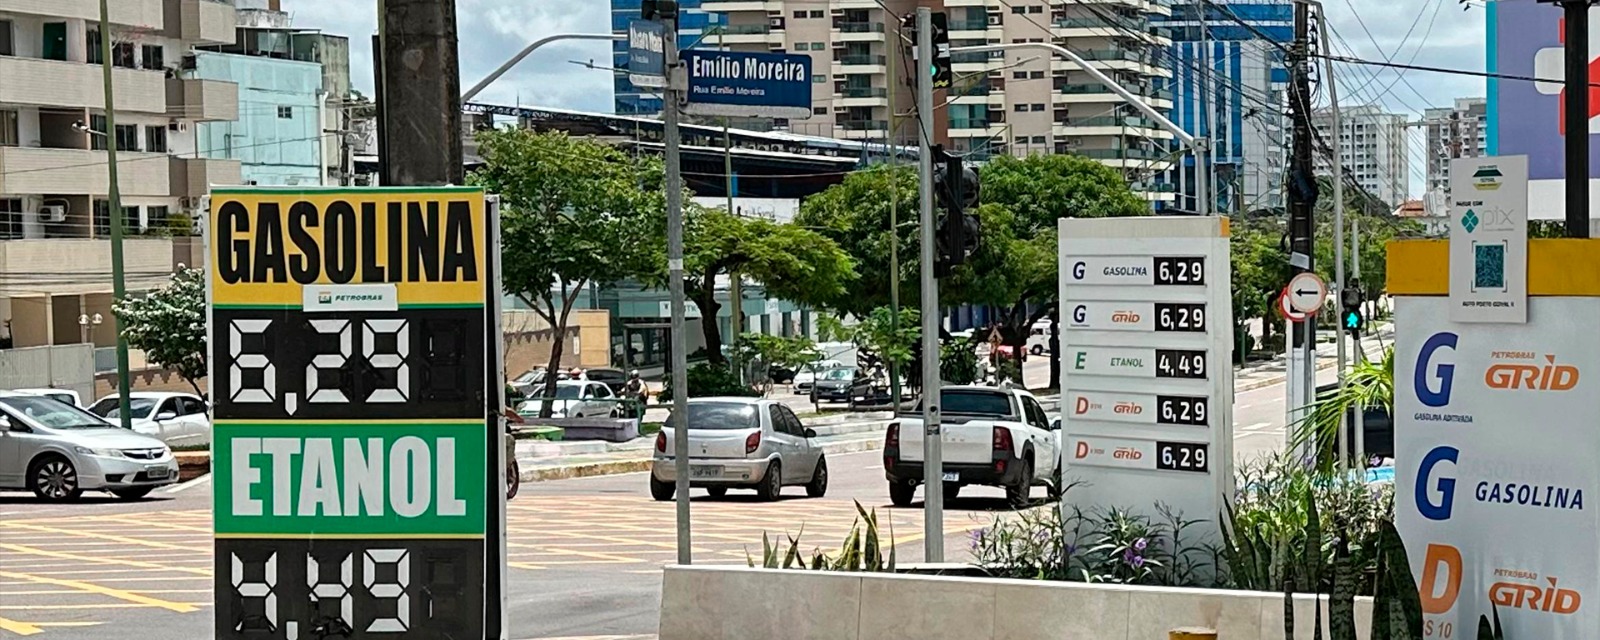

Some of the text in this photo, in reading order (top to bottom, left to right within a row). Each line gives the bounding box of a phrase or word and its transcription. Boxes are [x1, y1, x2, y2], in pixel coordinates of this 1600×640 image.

[692, 54, 804, 81] Emílio Moreira
[693, 85, 709, 94] Rua
[736, 86, 765, 96] Moreira
[1482, 206, 1514, 231] pix
[217, 200, 478, 284] GASOLINA
[1072, 261, 1148, 280] G GASOLINA
[1159, 261, 1202, 284] 6,29
[1073, 304, 1087, 323] G
[1160, 308, 1203, 330] 6,29
[1075, 351, 1144, 370] E ETANOL
[1158, 354, 1204, 376] 4,49
[1491, 351, 1536, 360] PETROBRAS
[229, 319, 410, 416] 6,29
[1413, 331, 1459, 408] G
[1484, 354, 1580, 391] GRID
[1075, 396, 1089, 415] D
[1113, 402, 1143, 415] GRID
[1162, 400, 1205, 422] 6,29
[1075, 441, 1089, 459] D
[1113, 447, 1143, 460] GRID
[1162, 446, 1206, 469] 6,29
[231, 435, 467, 518] ETANOL
[1414, 445, 1460, 521] G
[1475, 481, 1583, 510] GASOLINA
[1420, 543, 1463, 615] D
[1494, 568, 1538, 580] PETROBRAS
[231, 548, 410, 640] 4,49
[1488, 576, 1582, 614] GRID
[1438, 621, 1452, 639] 10
